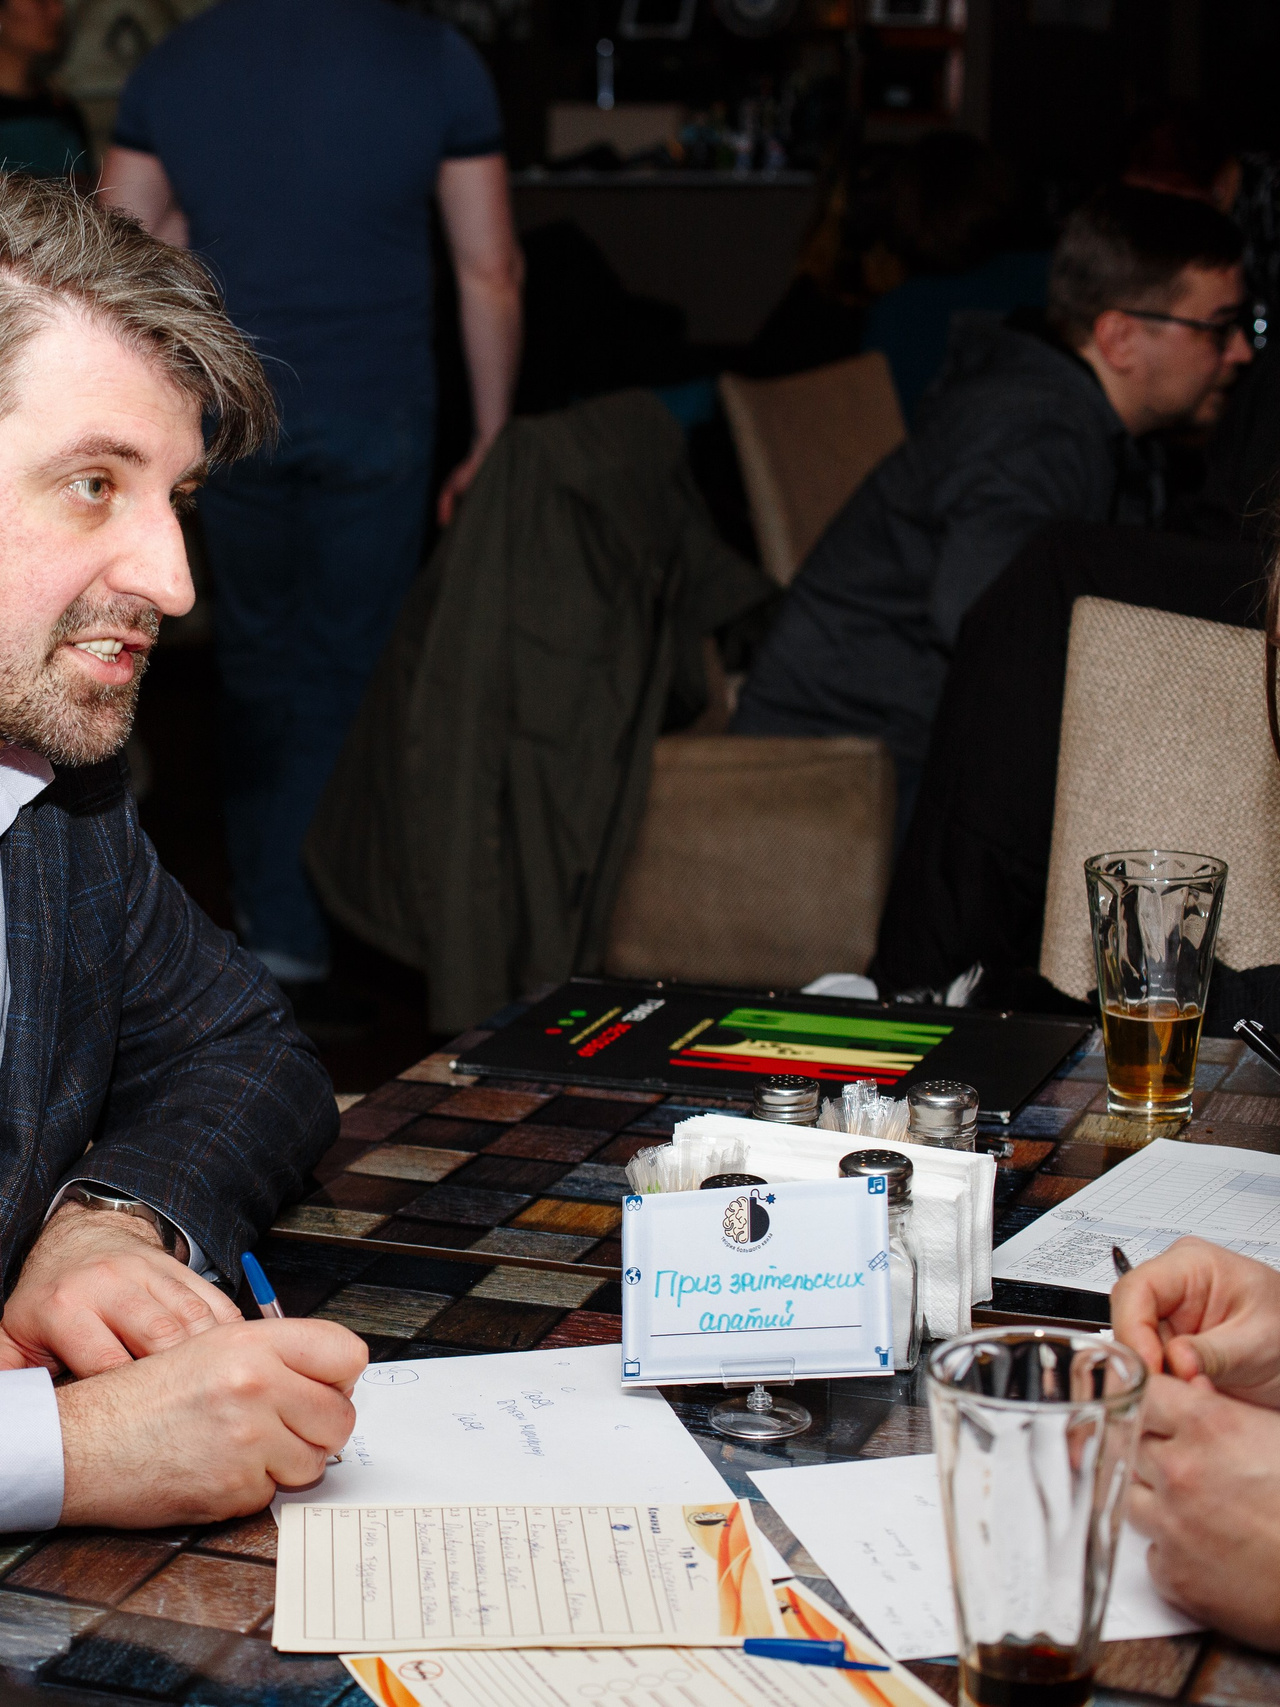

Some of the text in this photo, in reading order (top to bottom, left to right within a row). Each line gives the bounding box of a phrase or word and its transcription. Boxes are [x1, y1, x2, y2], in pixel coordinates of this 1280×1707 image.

[654, 1269, 722, 1307] Приз
[698, 1300, 795, 1333] апатий
[647, 1507, 661, 1534] Команда
[679, 1546, 695, 1559] Тур
